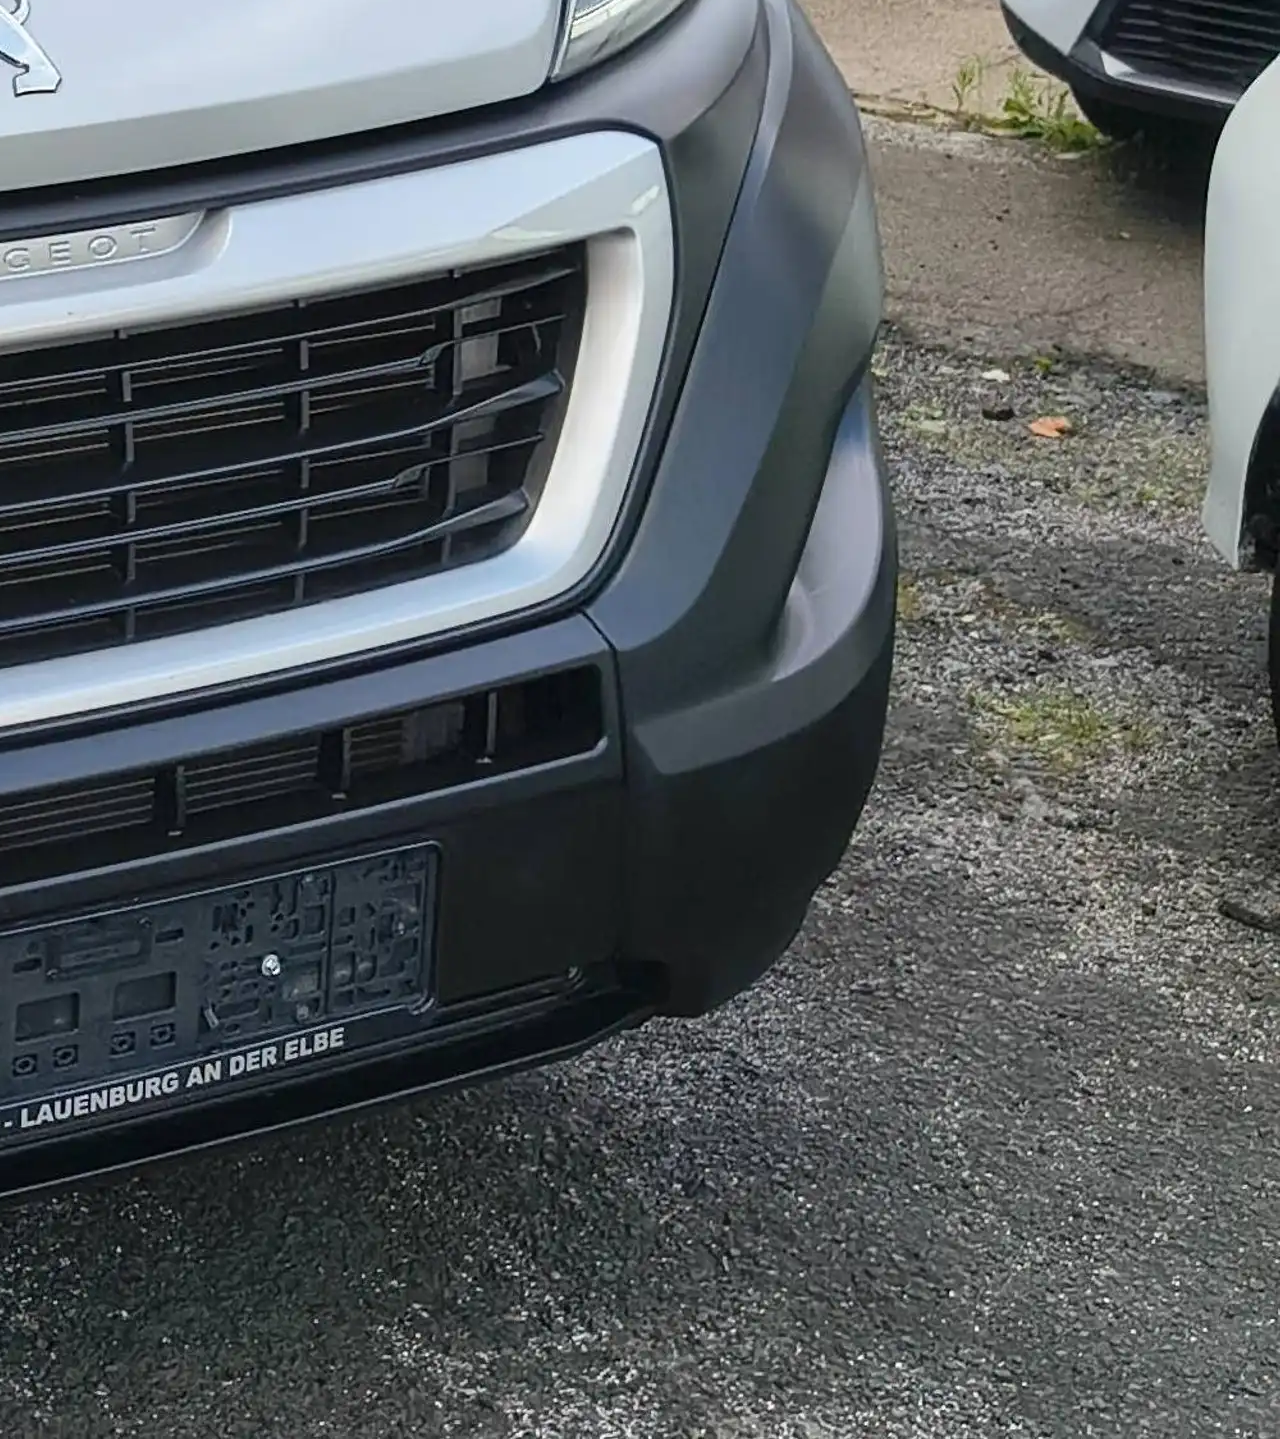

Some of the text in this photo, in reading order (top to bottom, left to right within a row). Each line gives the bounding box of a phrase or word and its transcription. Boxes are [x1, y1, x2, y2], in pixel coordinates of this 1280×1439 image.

[20, 1072, 179, 1129] LAUENBURG
[186, 1060, 221, 1088] AN
[229, 1048, 278, 1076] DER
[285, 1026, 346, 1061] ELBE
